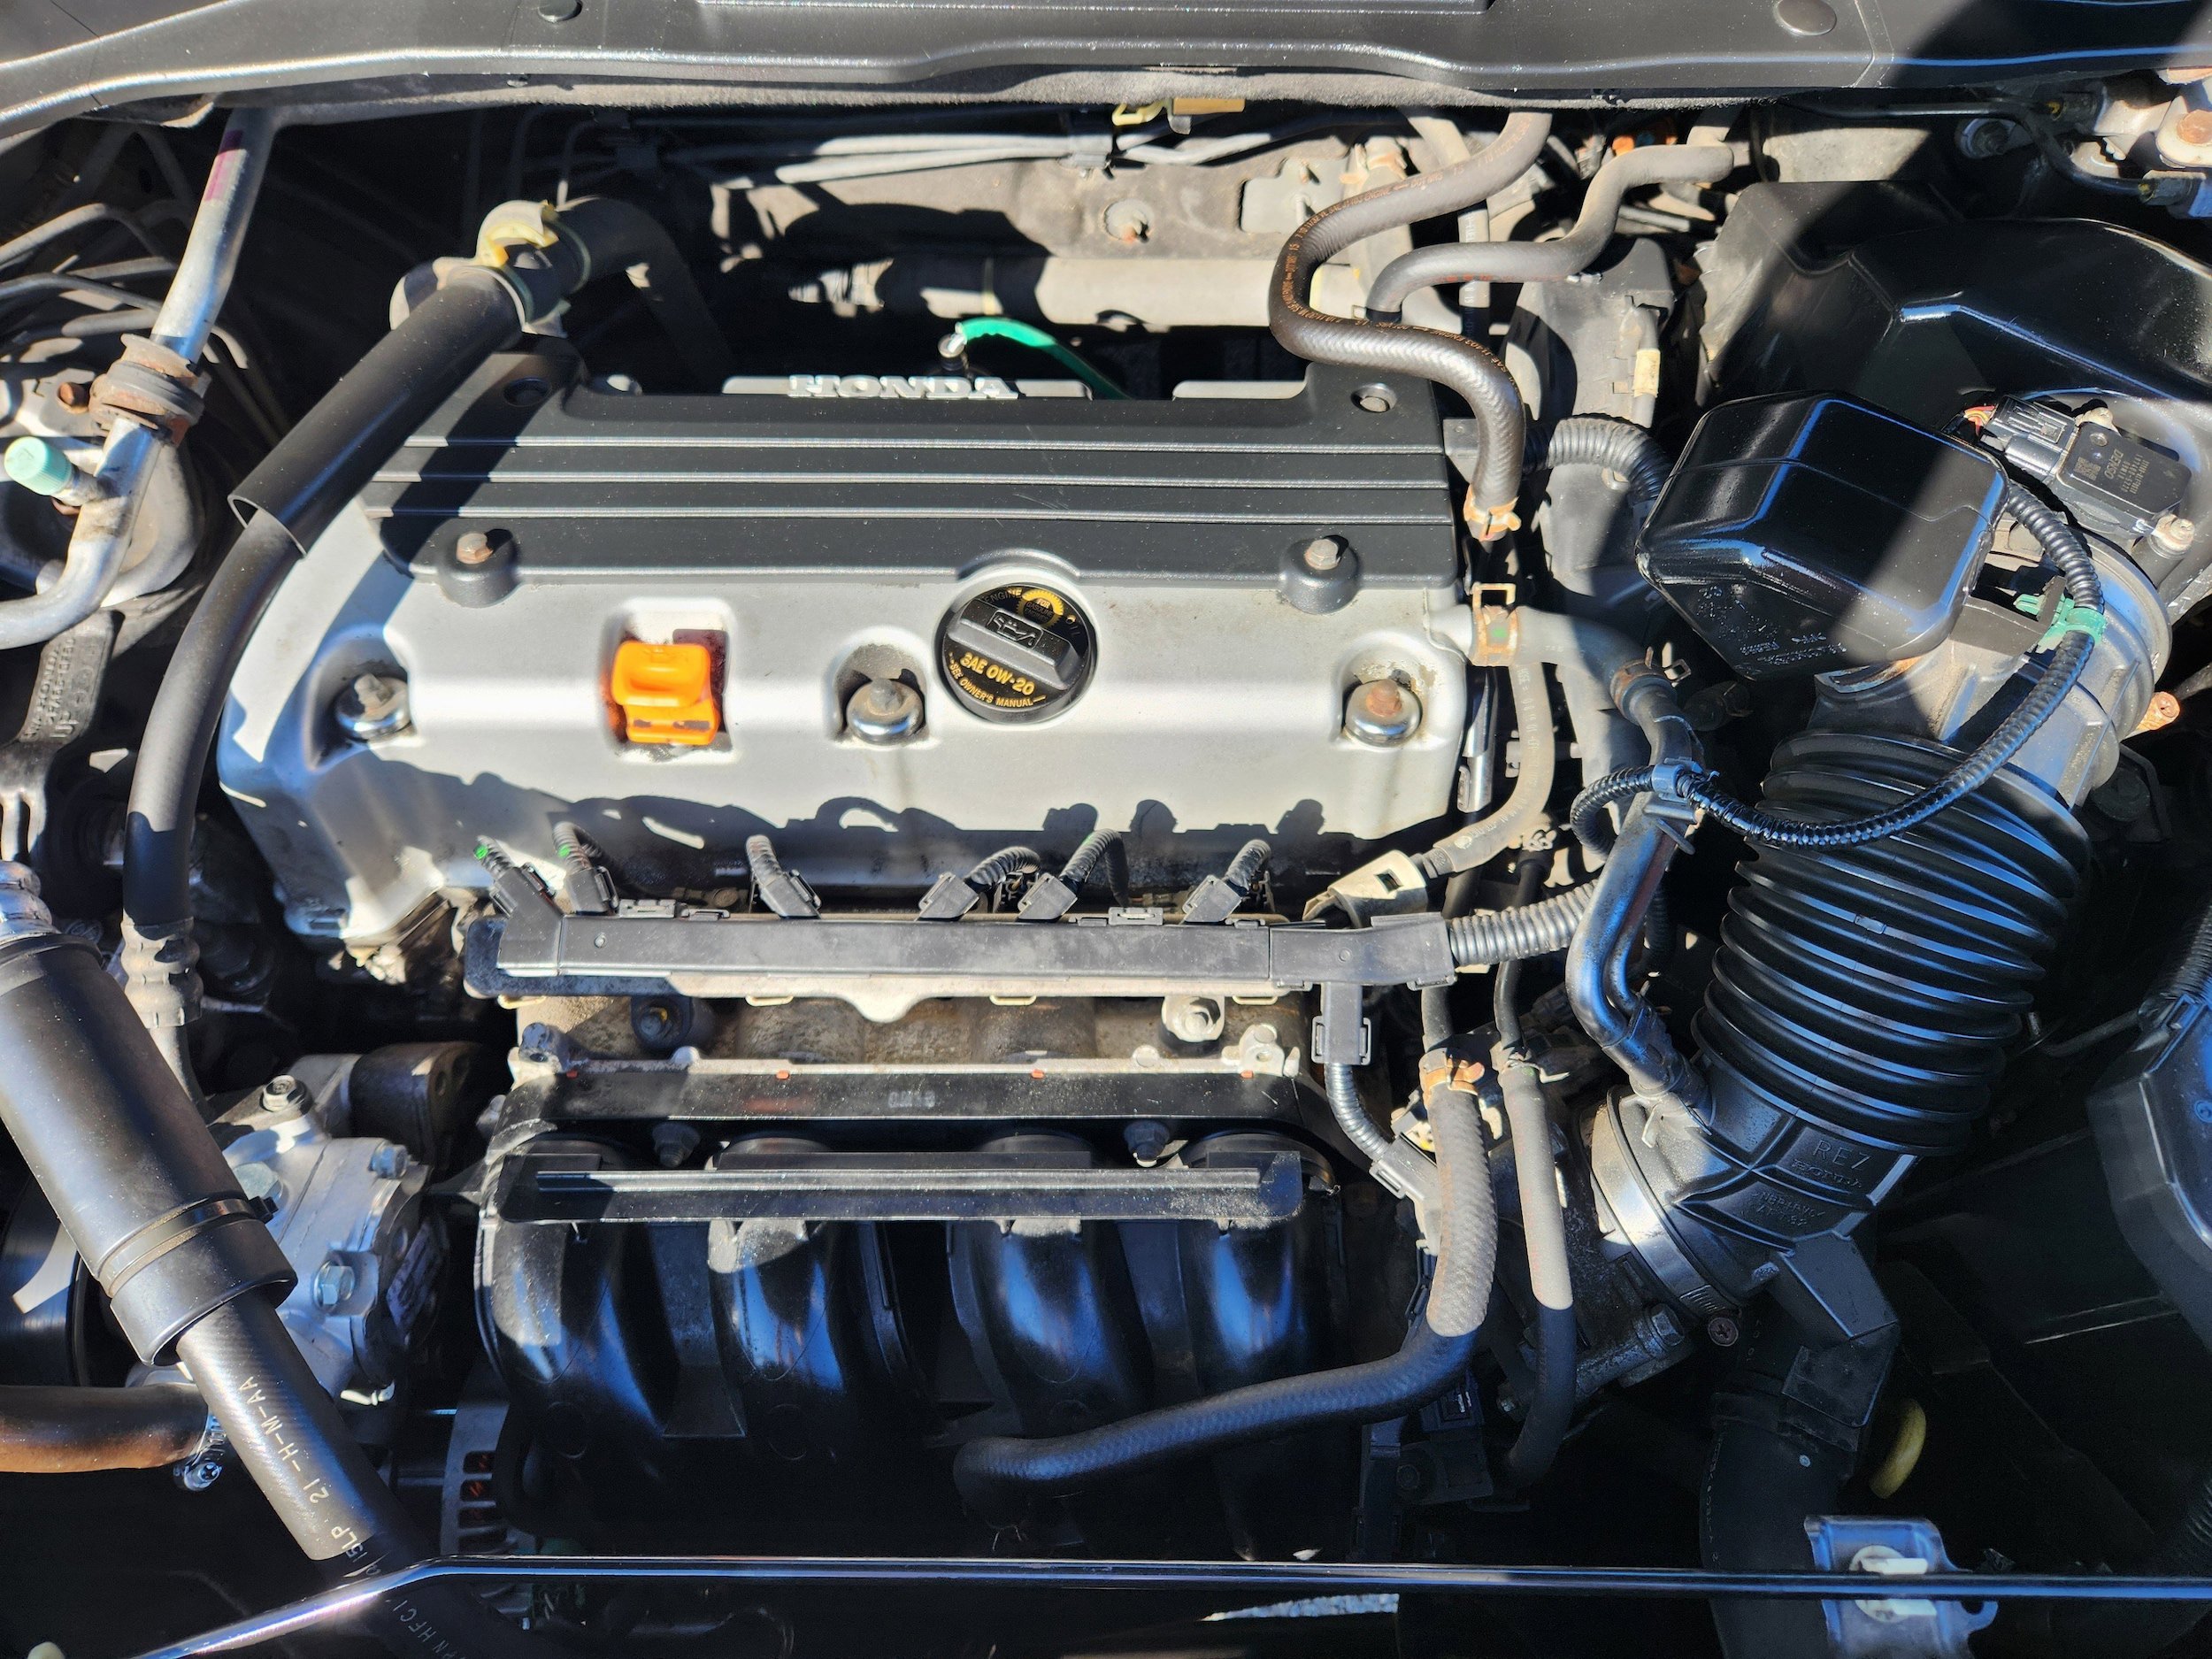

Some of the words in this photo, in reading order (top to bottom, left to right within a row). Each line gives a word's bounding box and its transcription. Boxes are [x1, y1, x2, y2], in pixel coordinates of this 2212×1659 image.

[787, 374, 1018, 400] HONDA
[2104, 448, 2124, 480] DENSO
[984, 588, 1023, 604] ENGINE
[1035, 598, 1051, 610] FOR
[960, 652, 988, 675] SAE
[949, 661, 964, 680] SEE
[960, 678, 995, 703] OWNER'S
[995, 696, 1033, 709] MANUAL
